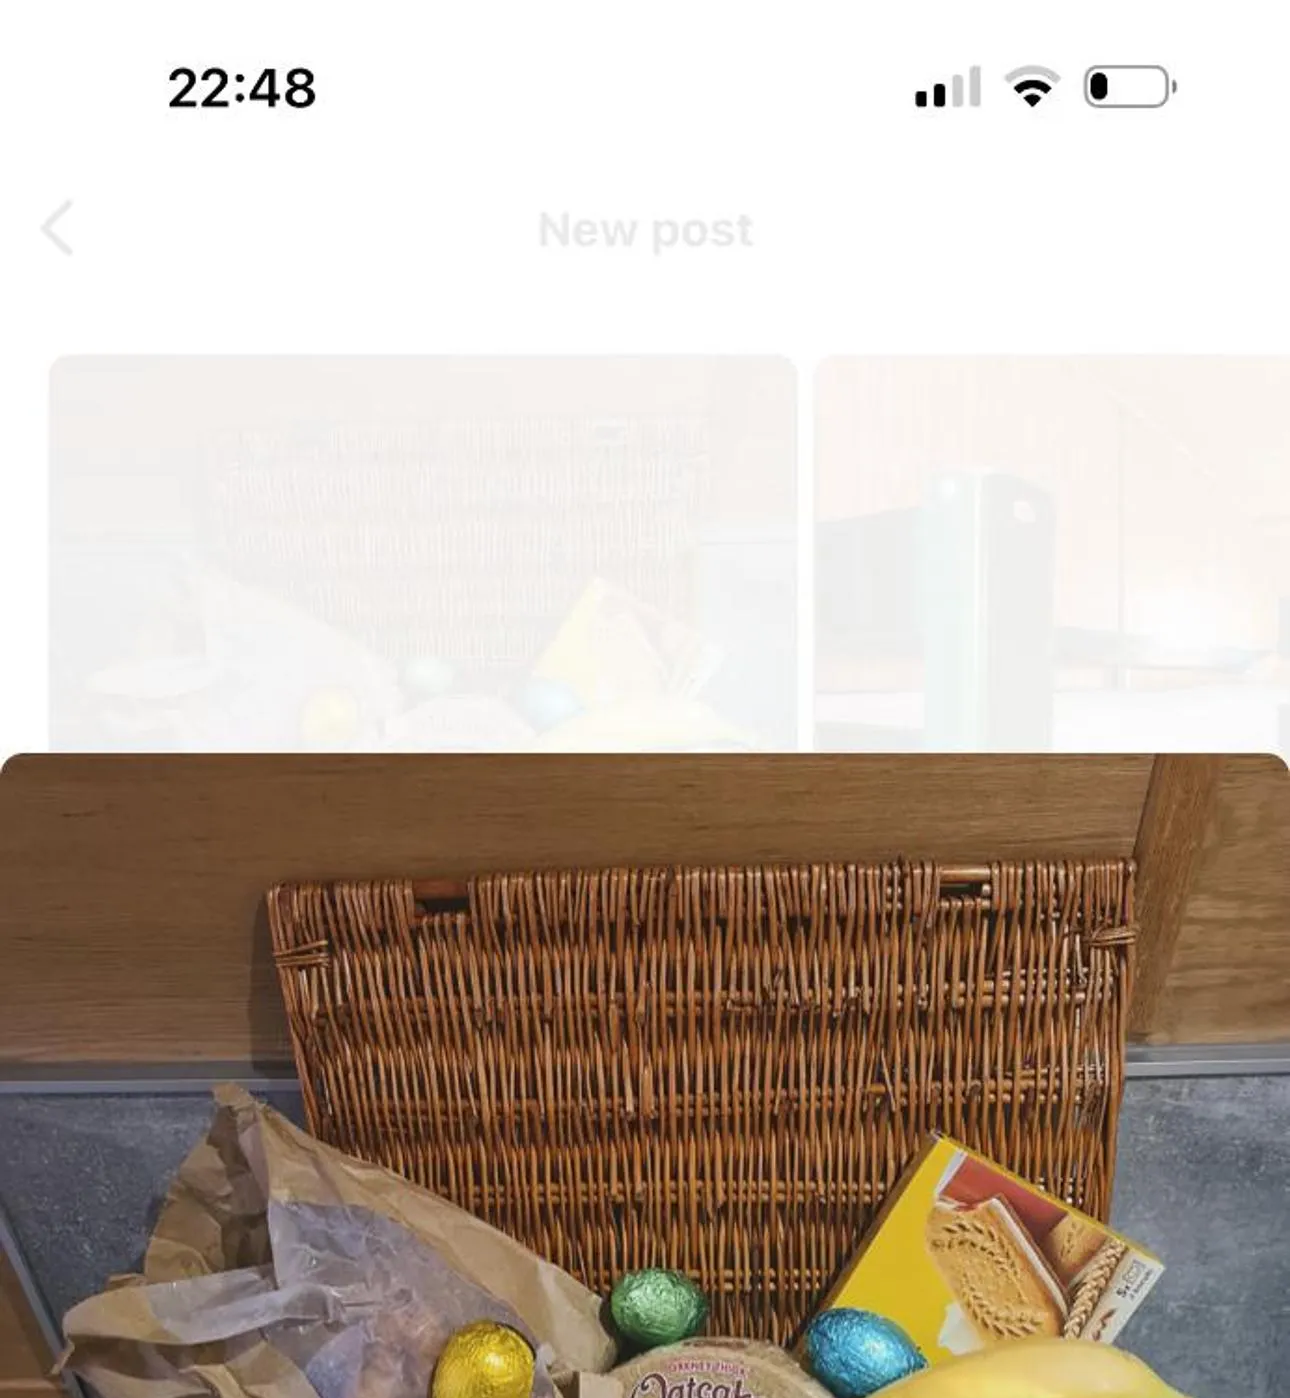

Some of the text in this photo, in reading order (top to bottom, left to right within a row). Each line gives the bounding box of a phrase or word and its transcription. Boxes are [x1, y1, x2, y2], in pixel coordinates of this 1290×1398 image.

[168, 66, 317, 109] 22:48
[538, 210, 755, 257] New post
